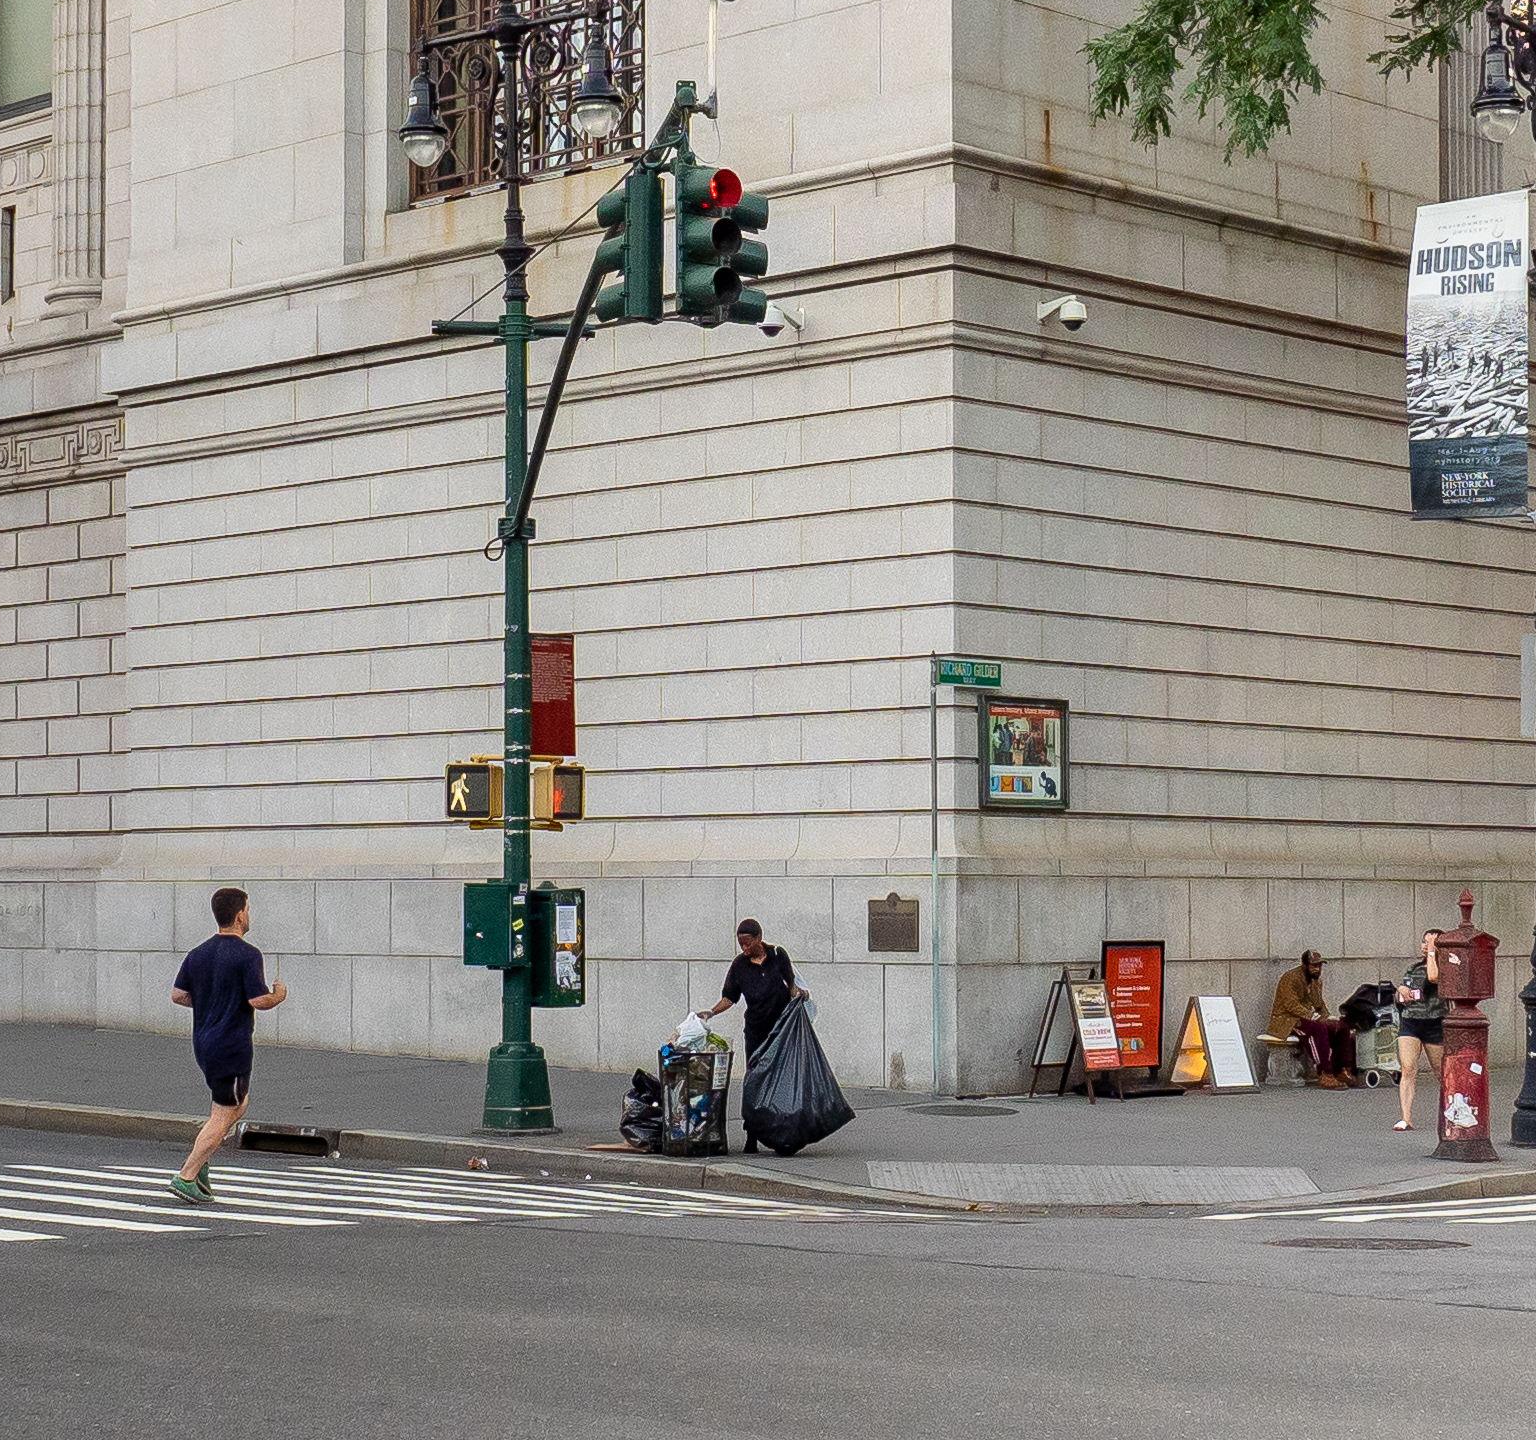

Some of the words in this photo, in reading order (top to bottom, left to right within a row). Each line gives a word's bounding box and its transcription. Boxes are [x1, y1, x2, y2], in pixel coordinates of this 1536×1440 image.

[1416, 238, 1522, 276] HUDSON
[1440, 272, 1495, 296] RISING
[1441, 479, 1497, 489] HISTORICAL
[1441, 488, 1479, 497] SOCIETY
[973, 664, 999, 679] GILDER
